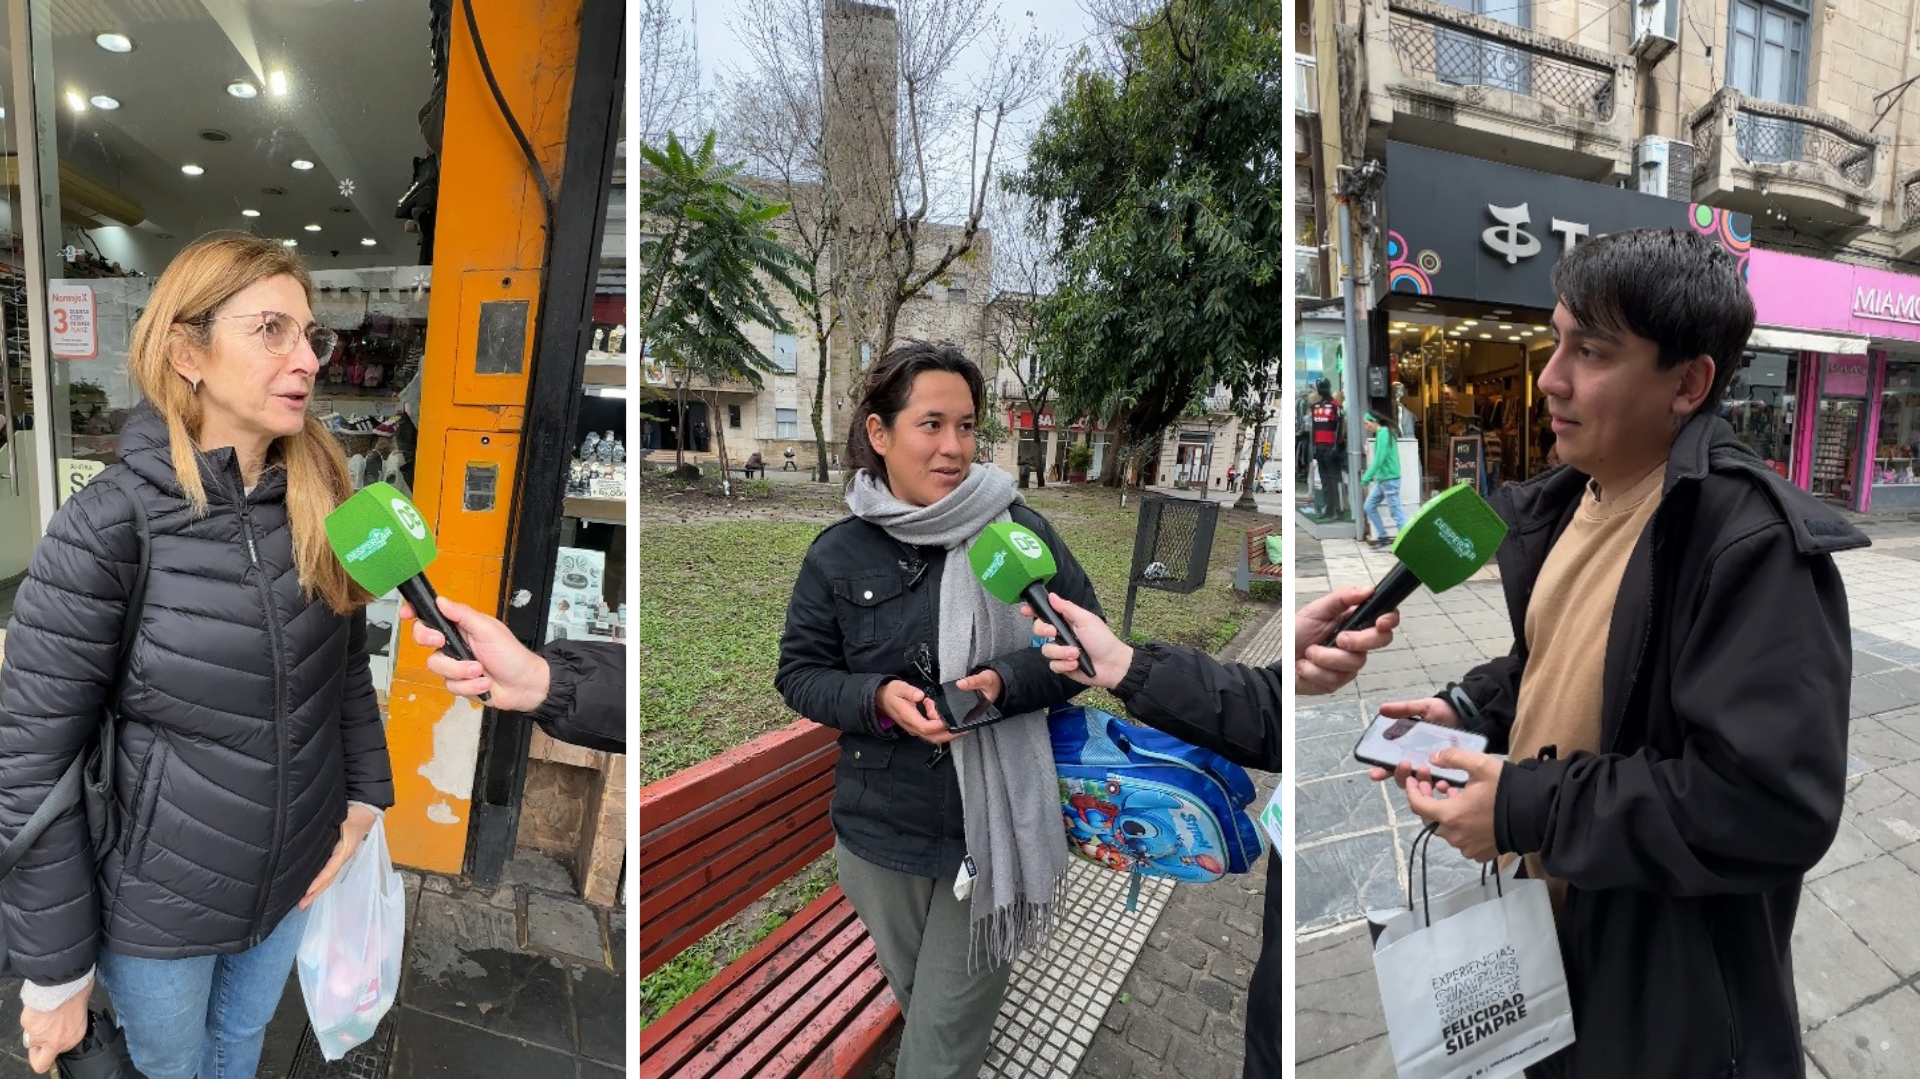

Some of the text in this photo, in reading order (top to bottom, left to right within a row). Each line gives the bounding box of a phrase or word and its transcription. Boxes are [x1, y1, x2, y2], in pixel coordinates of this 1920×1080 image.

[53, 308, 68, 334] 3
[1014, 536, 1040, 550] DE
[1432, 944, 1515, 990] EXPERIENCIAS
[1440, 979, 1521, 1027] MOMENTOS DE
[1442, 993, 1524, 1039] FELICIDAD
[1446, 1004, 1528, 1056] SIEMPRE
